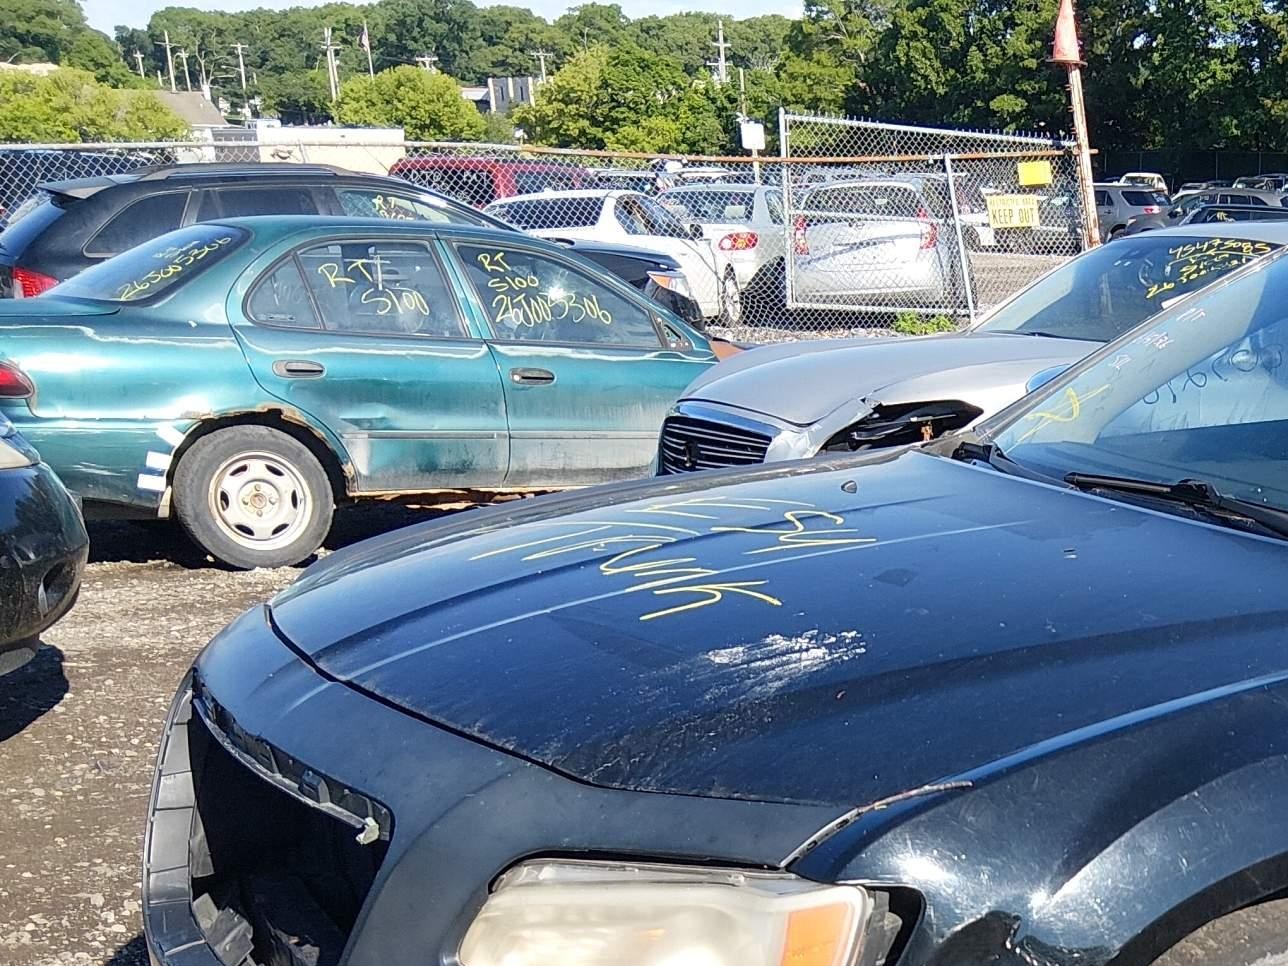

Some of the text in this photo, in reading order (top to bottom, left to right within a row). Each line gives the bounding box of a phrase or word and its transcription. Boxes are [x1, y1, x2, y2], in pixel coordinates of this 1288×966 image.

[991, 207, 1035, 225] KEEP OUT
[477, 252, 511, 272] RT
